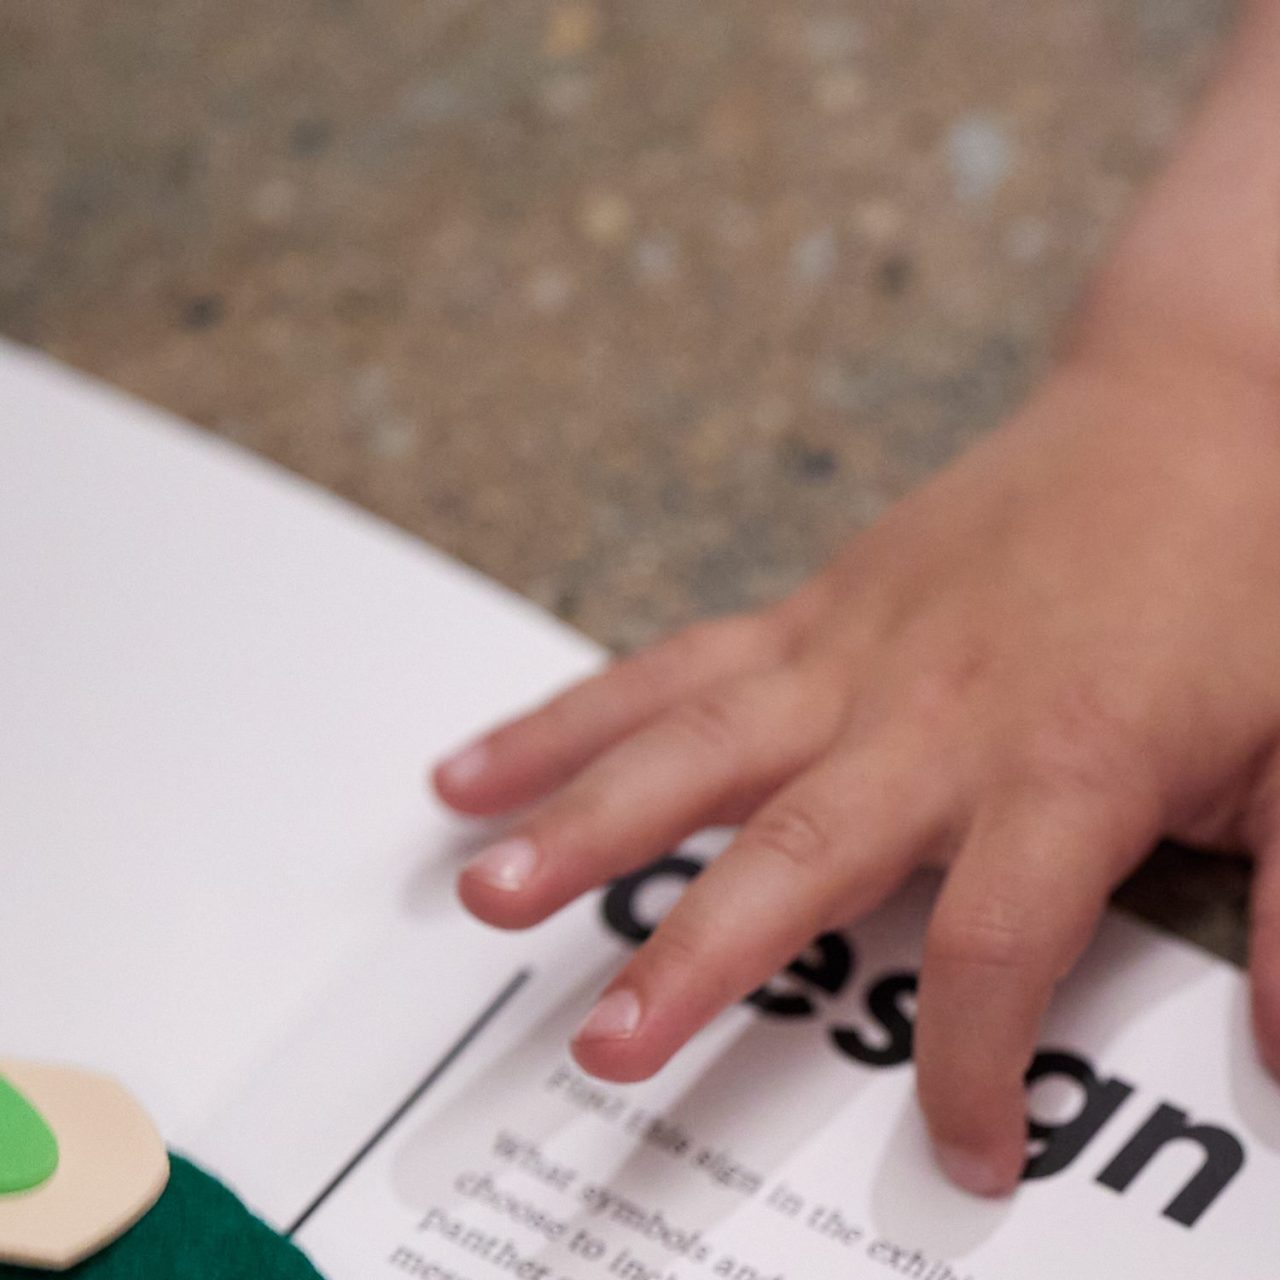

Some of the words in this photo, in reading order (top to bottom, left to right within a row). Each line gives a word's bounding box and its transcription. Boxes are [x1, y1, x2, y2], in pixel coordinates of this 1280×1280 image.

[454, 1171, 568, 1237] choose
[568, 1232, 605, 1260] to
[494, 1130, 575, 1190] What
[580, 1185, 709, 1262] symbols
[696, 1148, 763, 1195] sign
[766, 1183, 803, 1216] in
[805, 1207, 863, 1246] the
